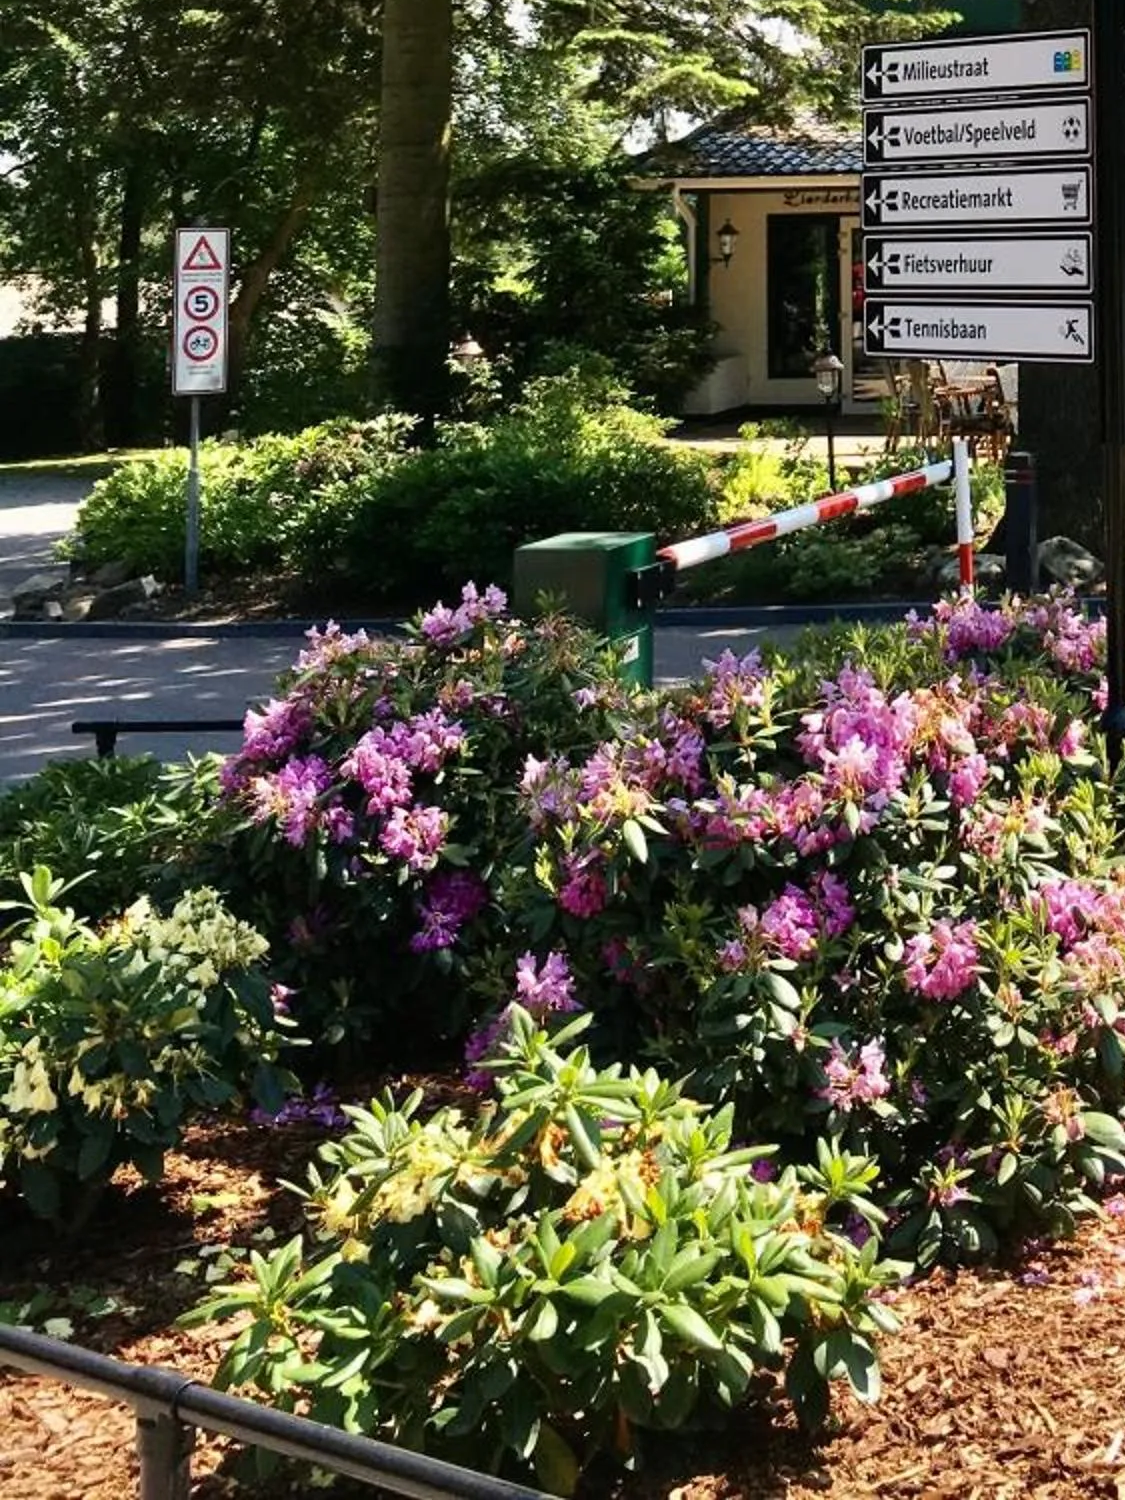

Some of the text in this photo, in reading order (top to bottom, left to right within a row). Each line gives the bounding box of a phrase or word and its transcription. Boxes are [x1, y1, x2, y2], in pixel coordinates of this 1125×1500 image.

[902, 57, 989, 81] Milieustraat
[904, 120, 1036, 148] Voetbal/Speelveld
[902, 188, 1013, 210] Recreatiemarkt
[903, 253, 993, 274] Fietsverhuur
[194, 295, 209, 313] 5
[904, 318, 987, 340] Tennisbaan
